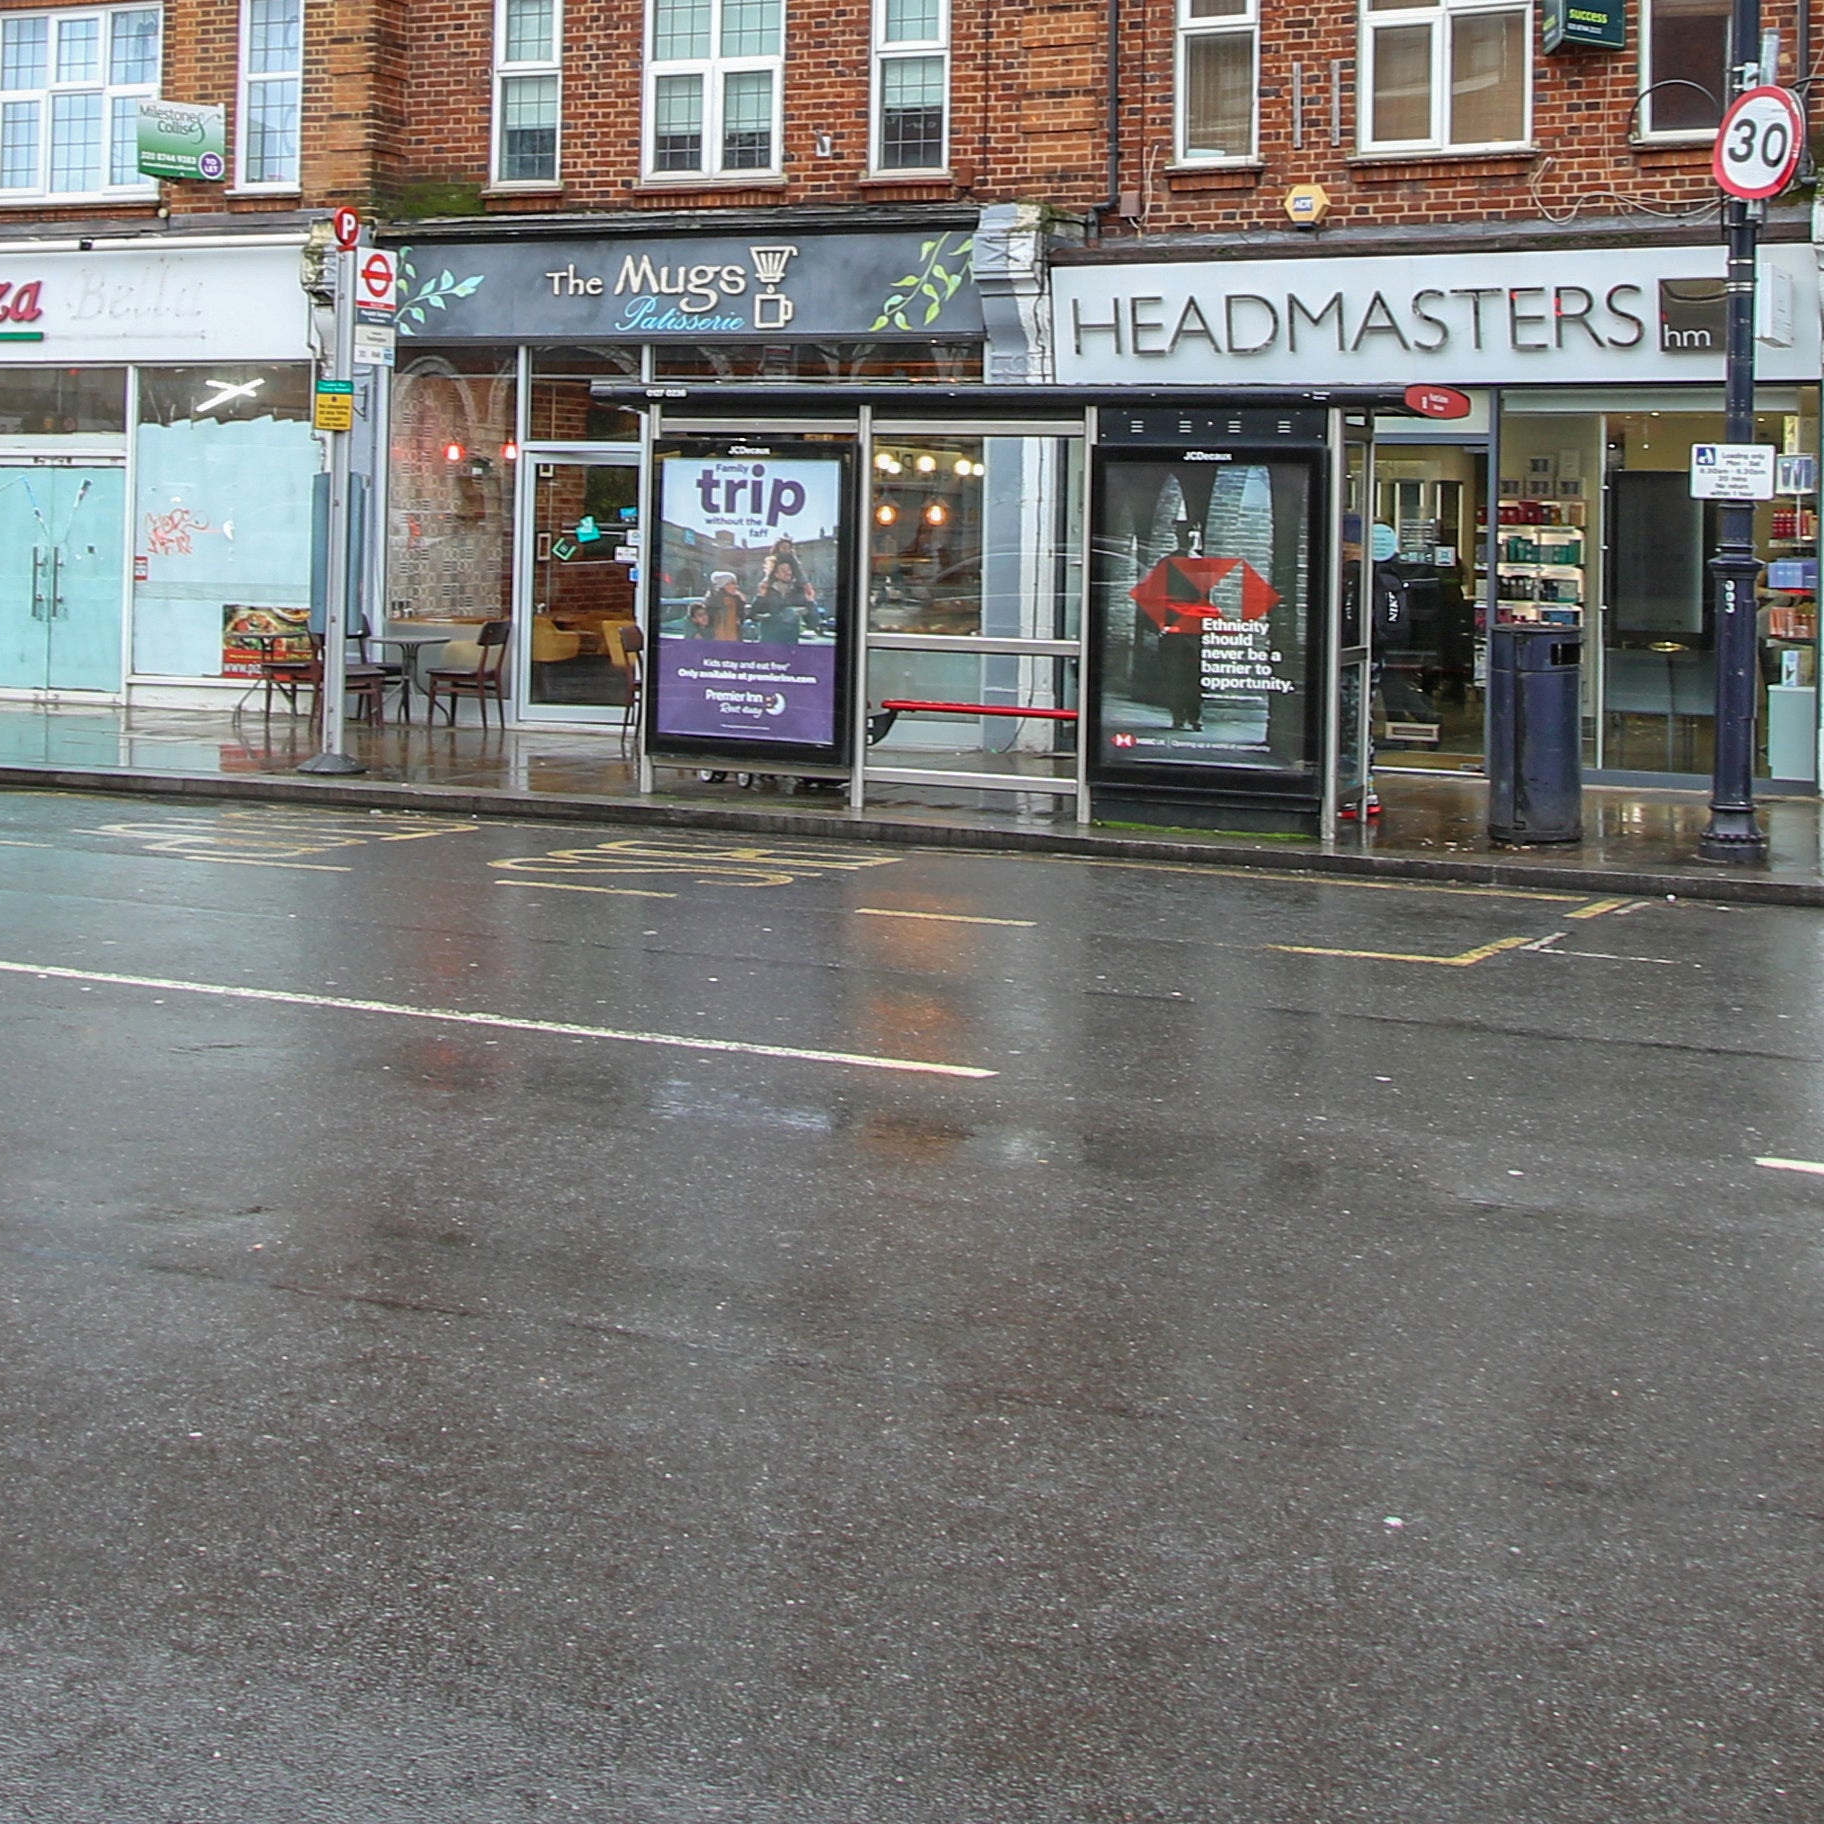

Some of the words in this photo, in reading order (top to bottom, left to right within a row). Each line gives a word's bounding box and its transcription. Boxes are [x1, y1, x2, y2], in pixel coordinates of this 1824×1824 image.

[1568, 8, 1608, 24] success
[140, 104, 198, 122] Milestone
[1728, 118, 1788, 168] 30
[204, 158, 217, 166] TO
[204, 165, 218, 173] LET
[342, 213, 356, 241] P
[546, 264, 604, 296] The
[613, 254, 747, 313] Mugs
[615, 295, 746, 331] Patisserie
[1071, 284, 1644, 357] HEADMASTERS
[1664, 320, 1712, 348] hm
[728, 446, 771, 455] JCDecaux
[1183, 451, 1232, 461] JCDecaux
[1722, 452, 1749, 460] Loading
[715, 463, 749, 475] Family
[696, 464, 806, 527] trip
[705, 517, 744, 526] without
[746, 517, 762, 526] the
[749, 528, 769, 538] faff
[1201, 618, 1269, 635] Ethnicity
[1201, 633, 1253, 646] should
[1201, 648, 1245, 660] never
[1247, 648, 1268, 661] be
[1270, 651, 1282, 662] a
[703, 658, 721, 668] Kids
[722, 660, 738, 671] stay
[739, 660, 755, 669] and
[756, 662, 769, 671] eat
[1201, 661, 1251, 674] barrier
[1255, 663, 1272, 676] to
[678, 668, 699, 679] Only
[699, 670, 737, 680] available
[738, 672, 746, 680] at
[746, 673, 817, 684] premierinn.com
[1200, 676, 1295, 693] opportunity.
[705, 689, 745, 702] Premier
[746, 691, 763, 703] Inn
[719, 702, 741, 714] Rest
